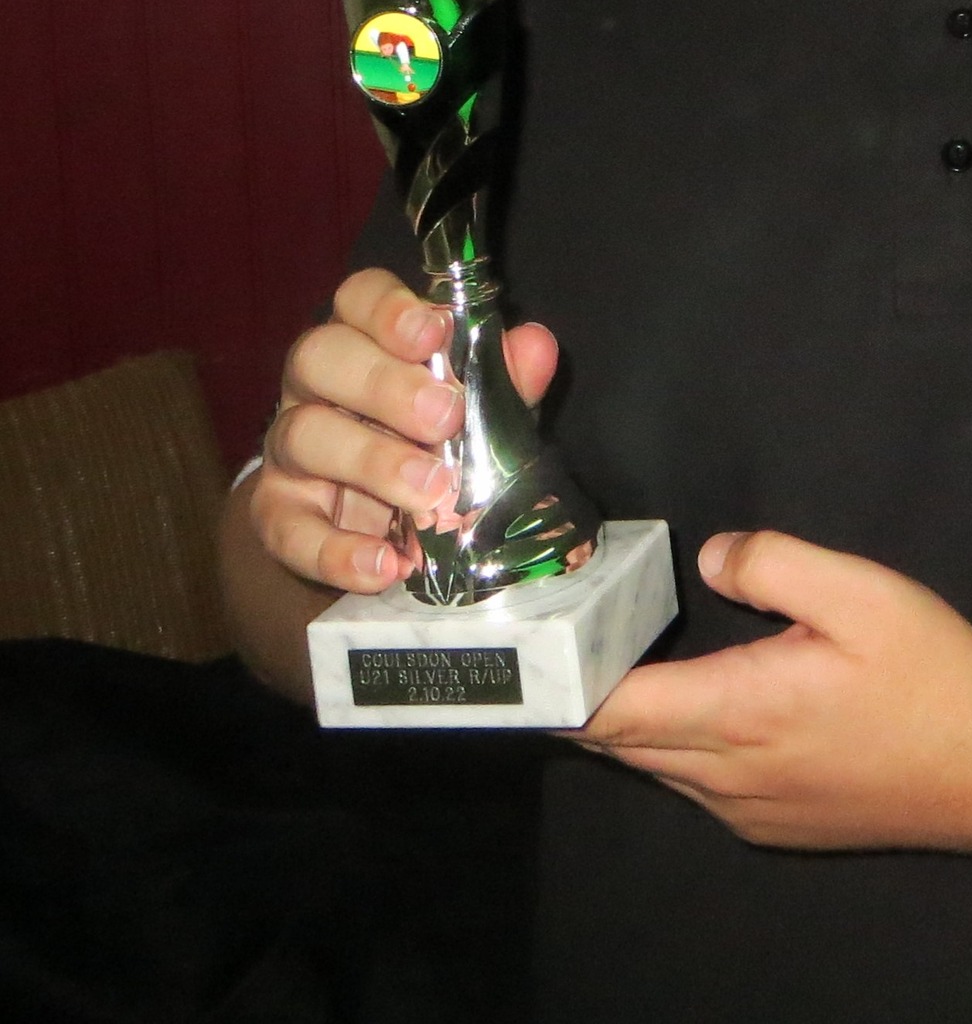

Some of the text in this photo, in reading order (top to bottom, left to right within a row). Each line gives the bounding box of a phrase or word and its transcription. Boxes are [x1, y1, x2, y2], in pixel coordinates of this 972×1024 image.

[362, 652, 506, 668] COULSDON OPEN
[360, 669, 512, 685] U21 SILVER R/UP
[408, 686, 466, 702] 2.10.22
